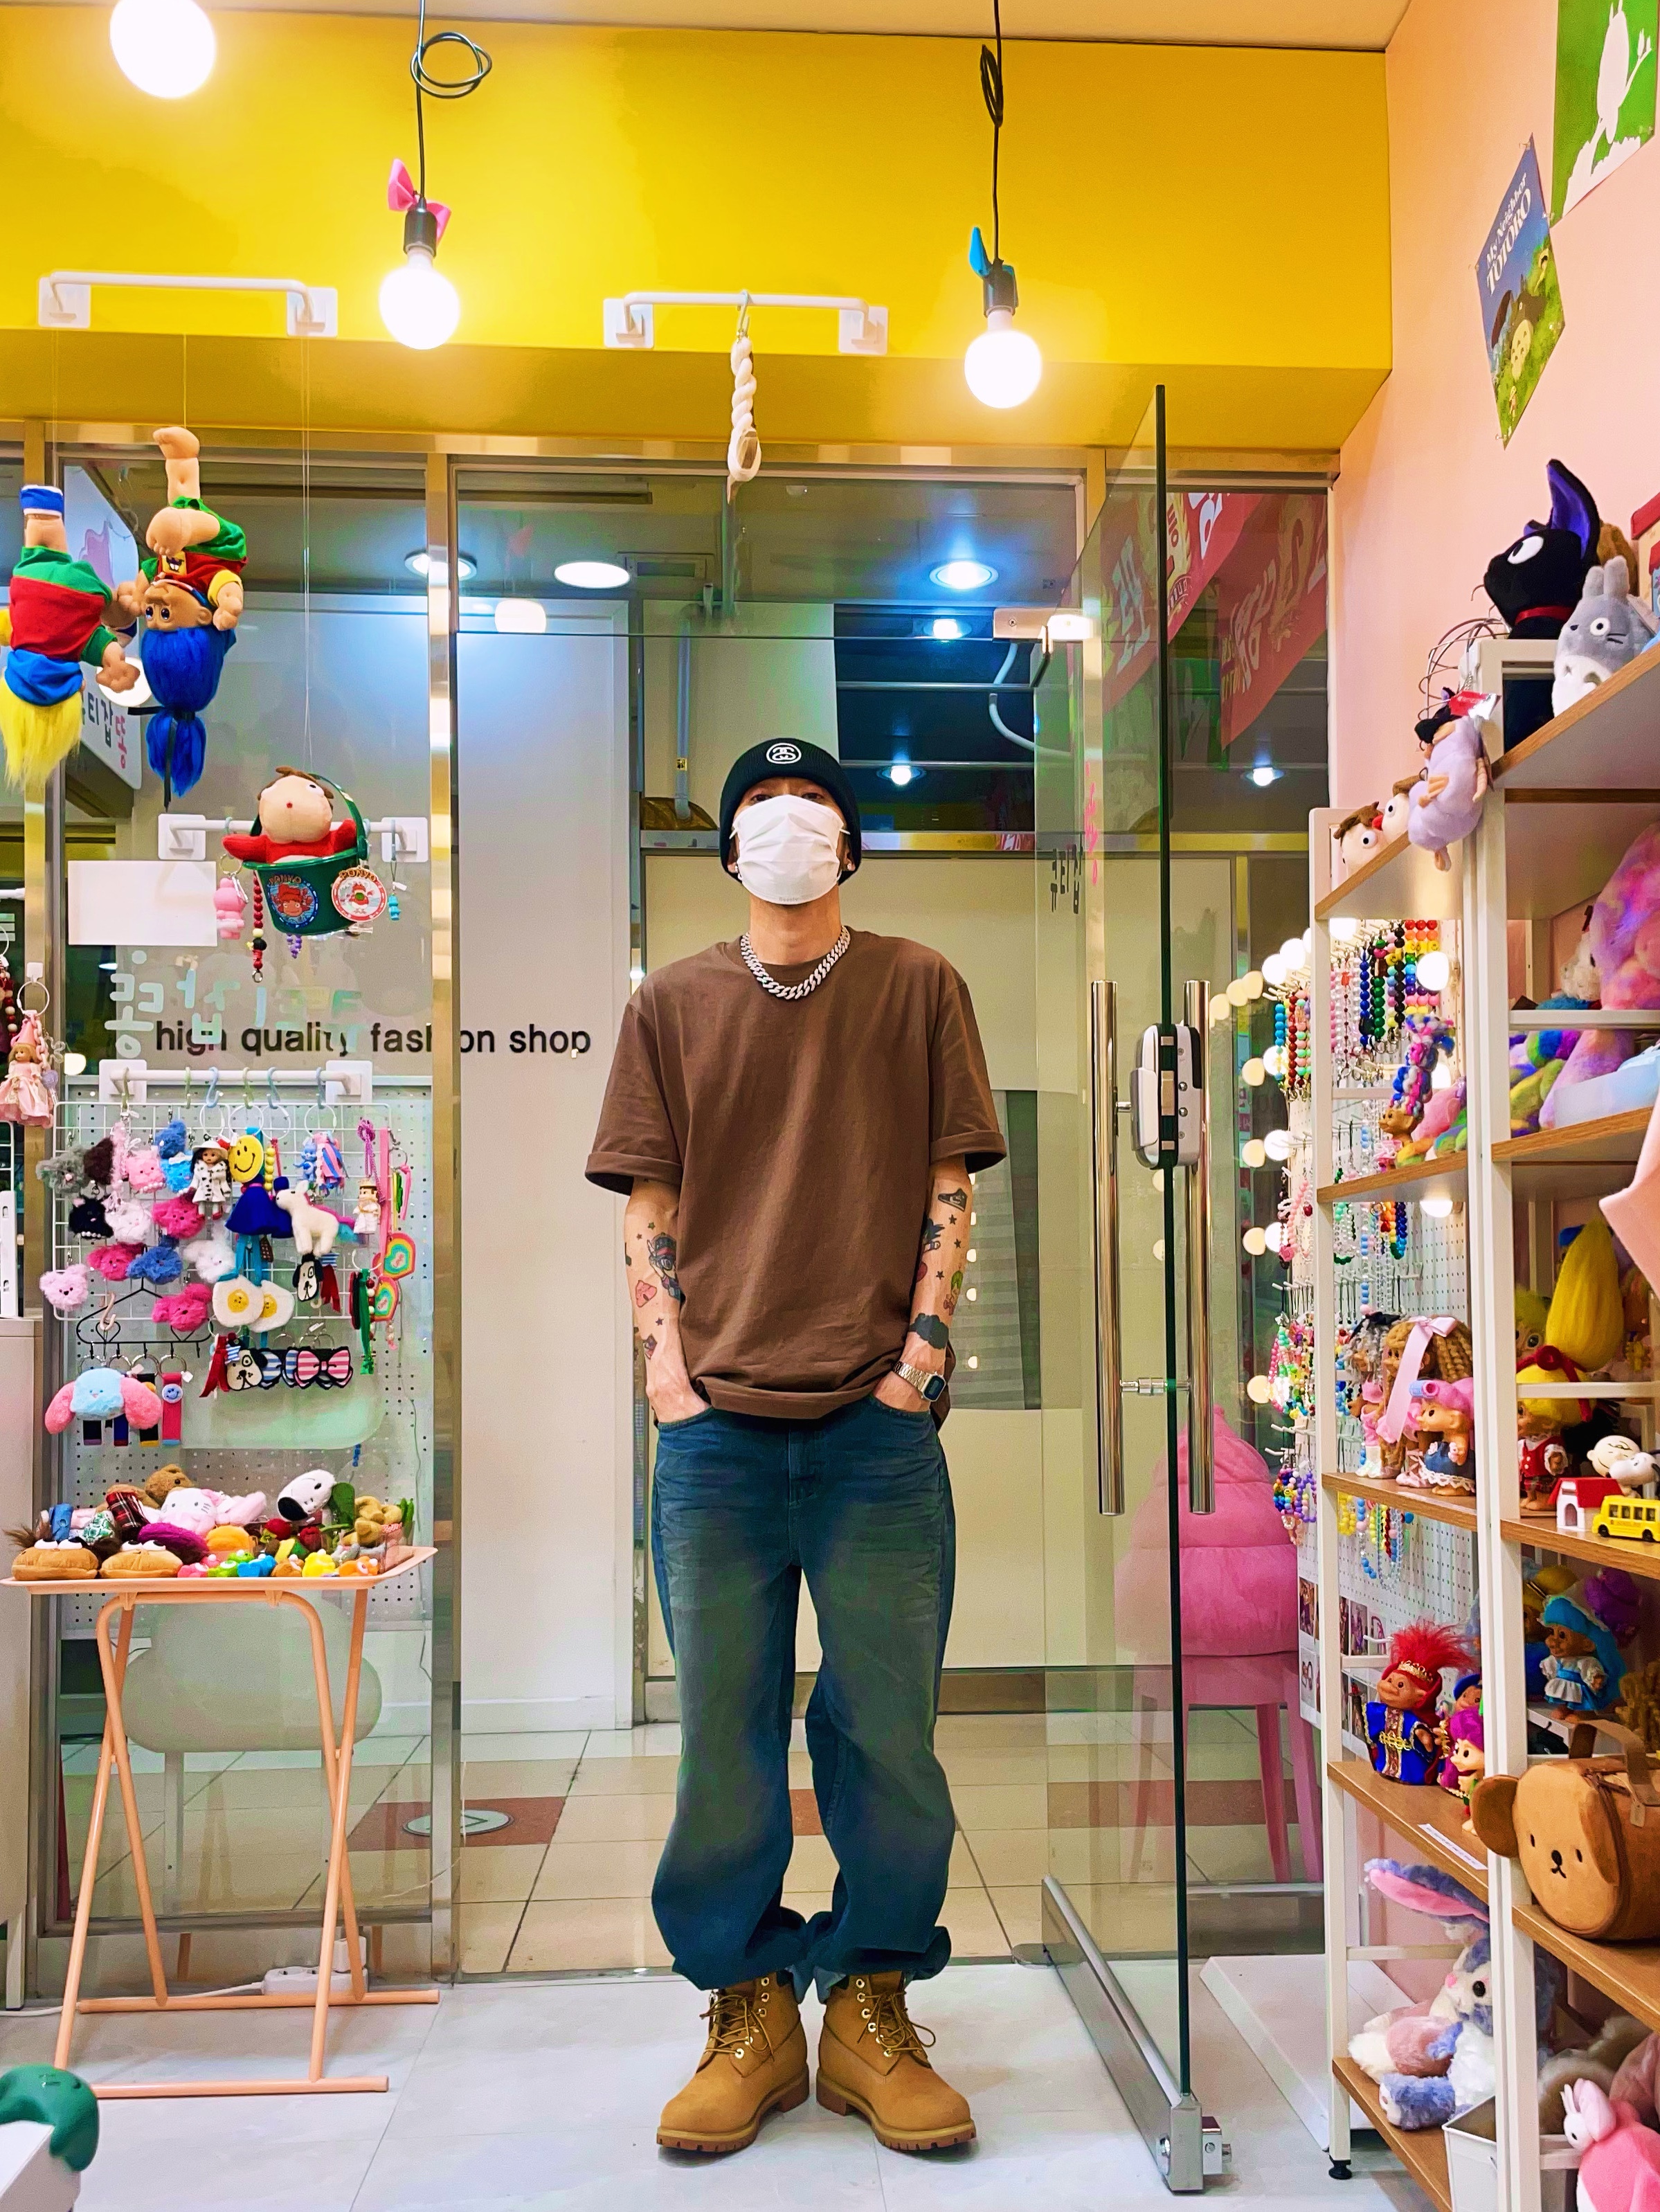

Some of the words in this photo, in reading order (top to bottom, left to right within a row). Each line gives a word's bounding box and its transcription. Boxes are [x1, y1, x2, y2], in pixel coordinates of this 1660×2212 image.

[1486, 243, 1498, 269] My
[1496, 172, 1527, 244] Neighbor
[1486, 188, 1531, 297] TOTORO
[82, 692, 127, 769] 티잡똥
[339, 867, 377, 882] PONYO
[370, 1022, 495, 1053] fason
[509, 1023, 590, 1058] shop
